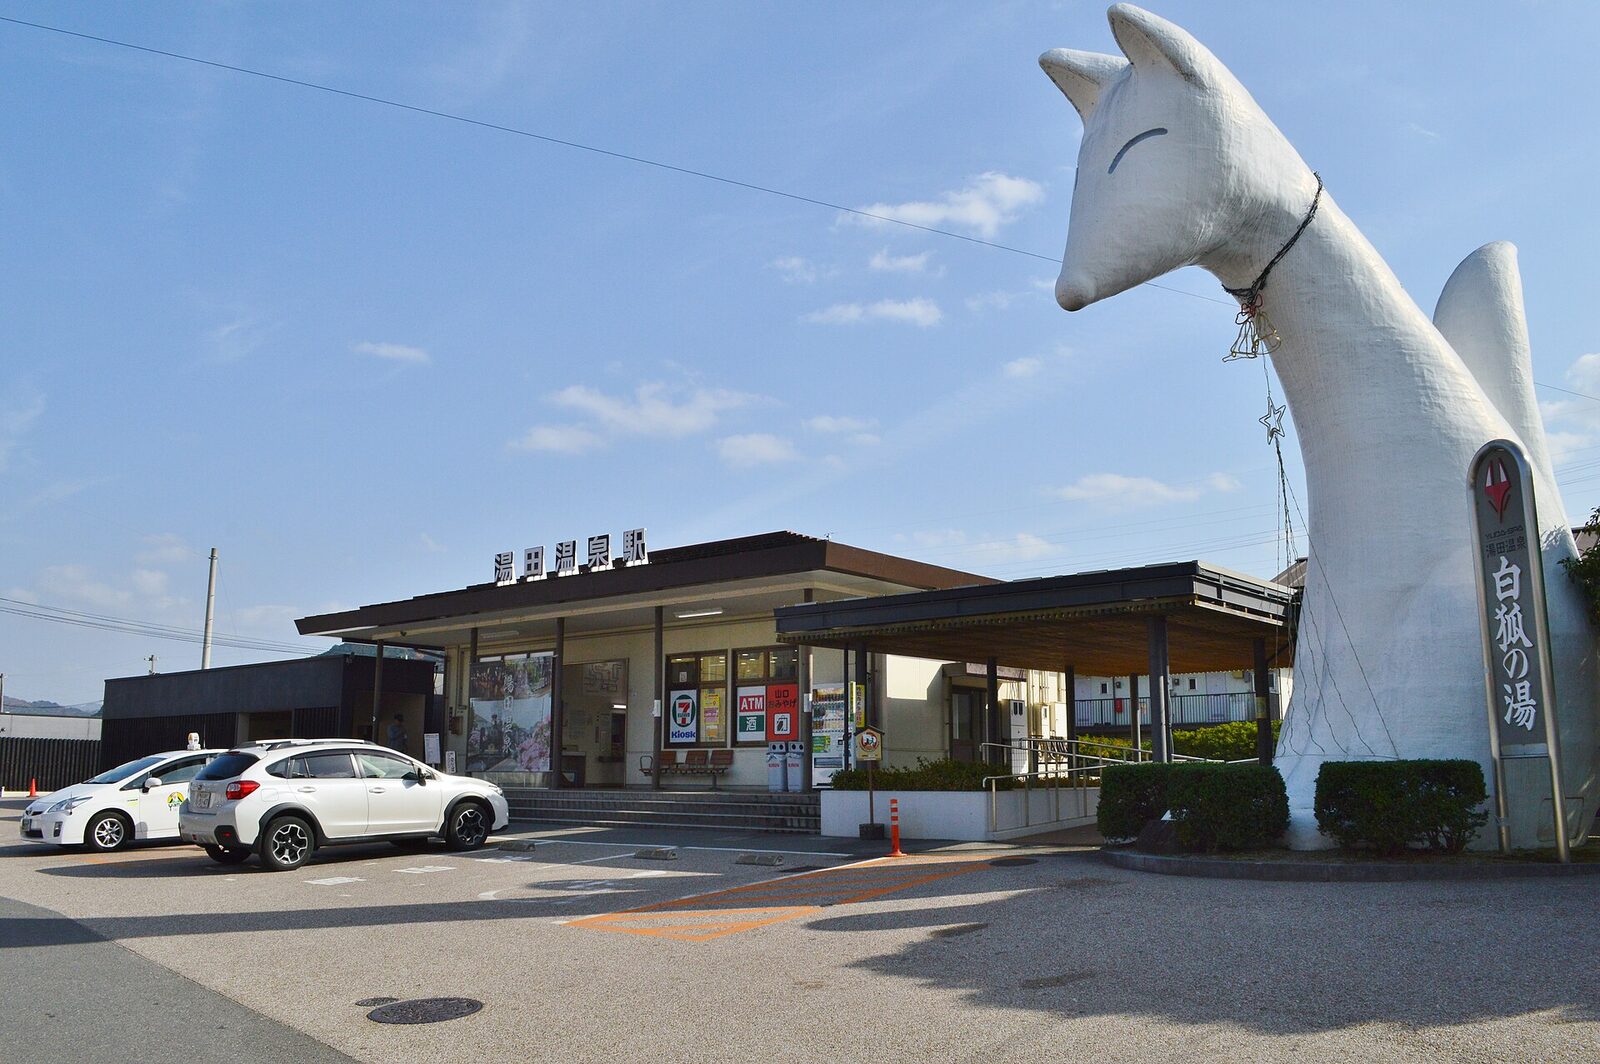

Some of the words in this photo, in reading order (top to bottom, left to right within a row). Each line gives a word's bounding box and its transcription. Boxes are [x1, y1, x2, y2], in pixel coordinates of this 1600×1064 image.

[1485, 535, 1528, 558] 湯田温泉
[494, 528, 647, 583] 湯田温泉駅
[1491, 556, 1537, 732] 白狐の湯
[774, 689, 790, 699] 山口
[740, 697, 764, 710] ATM
[768, 698, 797, 709] おみやげ
[745, 716, 757, 731] 酒
[671, 730, 696, 739] Kiosk
